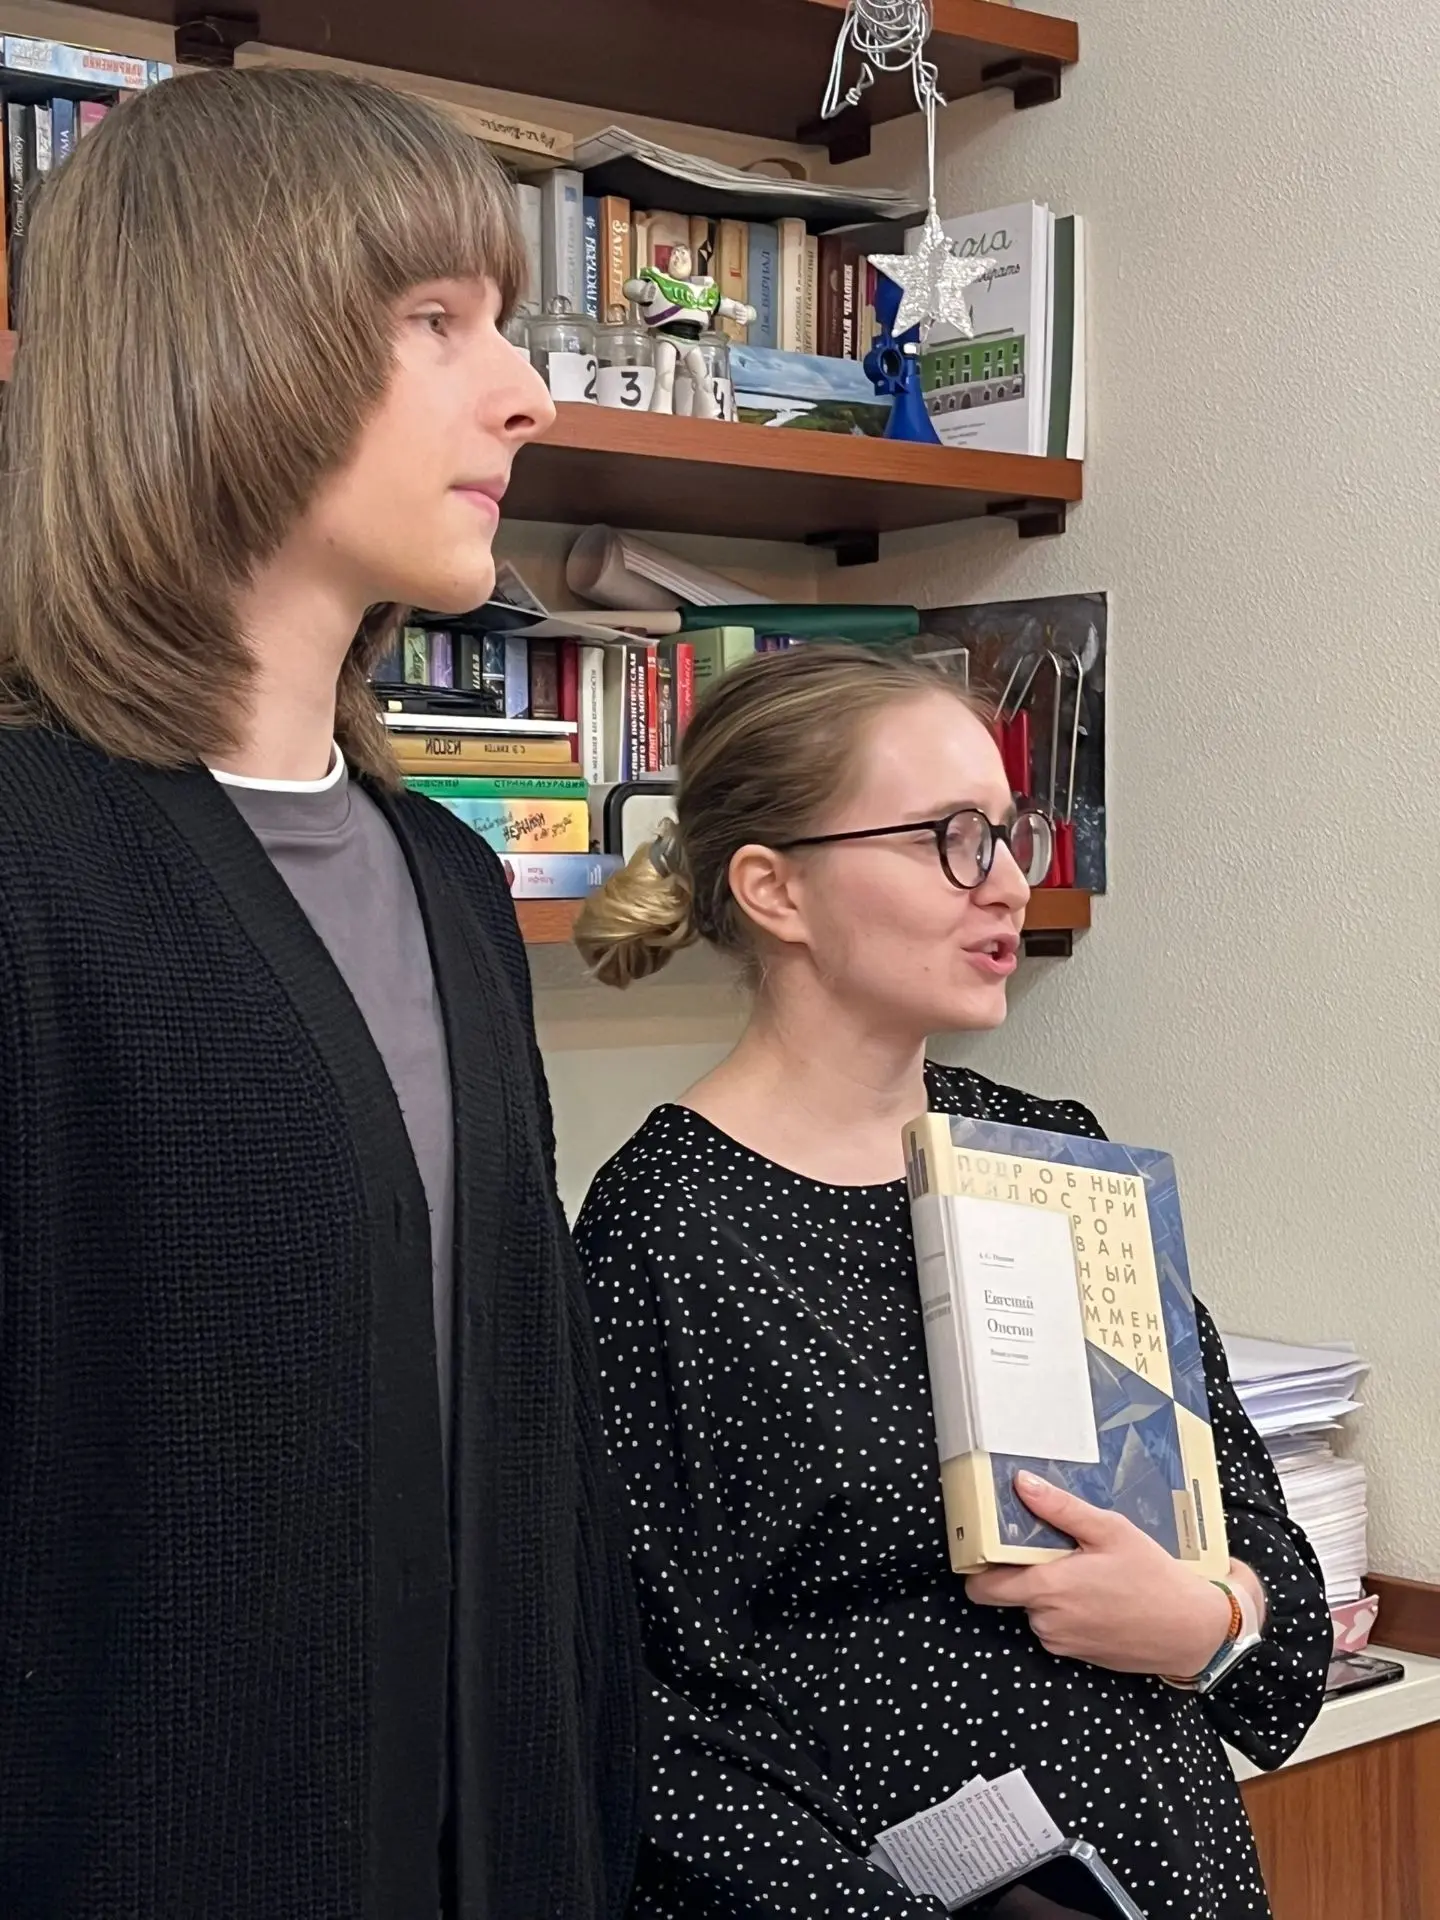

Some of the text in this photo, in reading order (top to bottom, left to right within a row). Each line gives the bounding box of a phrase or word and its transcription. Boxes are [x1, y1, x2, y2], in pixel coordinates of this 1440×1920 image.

[584, 359, 597, 399] 2
[620, 371, 642, 407] 3
[494, 780, 533, 789] СТРАНА
[535, 780, 586, 790] МУРАВИЯ
[984, 1289, 1034, 1310] Евгений
[987, 1318, 1034, 1338] Онегин
